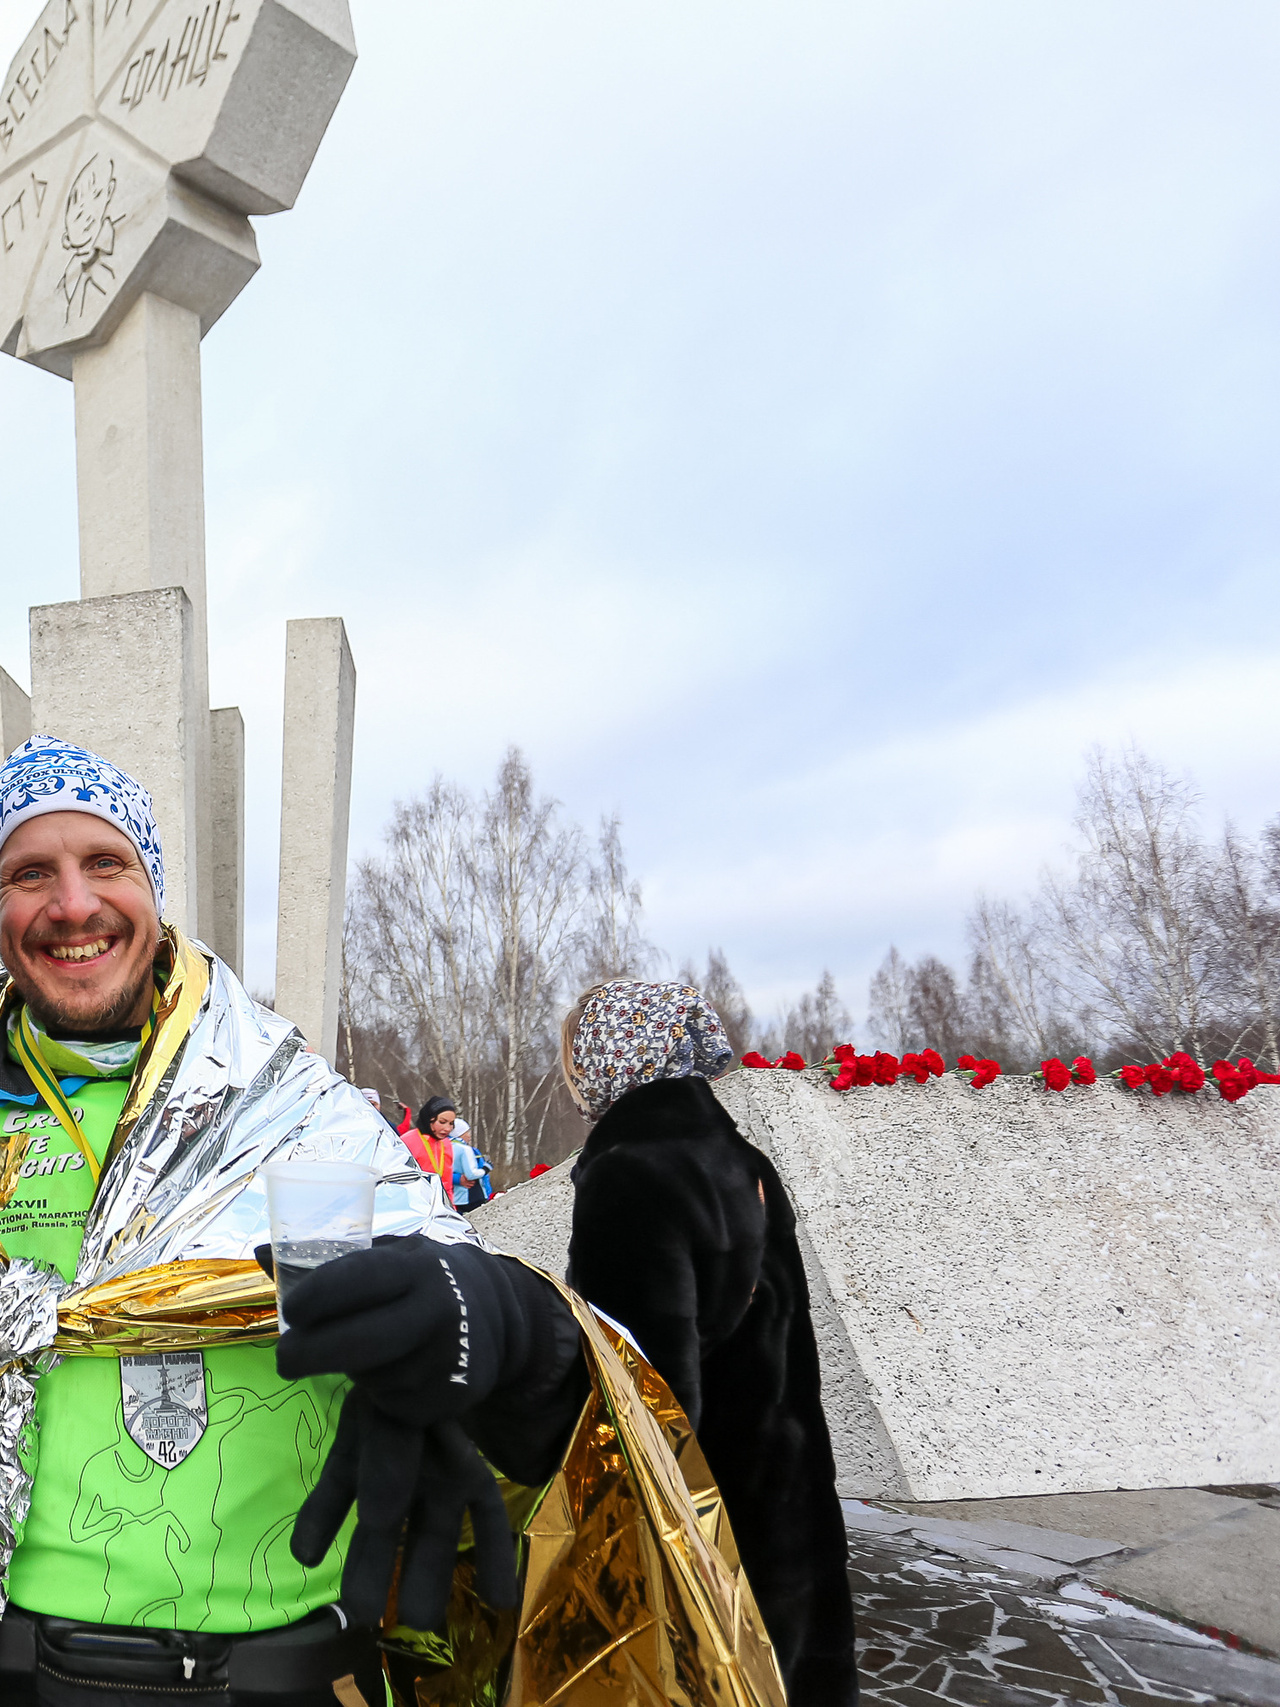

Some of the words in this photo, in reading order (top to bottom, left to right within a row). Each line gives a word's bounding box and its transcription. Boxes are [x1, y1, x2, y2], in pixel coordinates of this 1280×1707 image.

[1, 778, 24, 796] MAD
[26, 769, 50, 781] FOX
[52, 768, 92, 778] ULTRA
[19, 1151, 86, 1178] GHTS
[38, 1210, 89, 1219] MARATHO
[158, 1440, 177, 1463] 42
